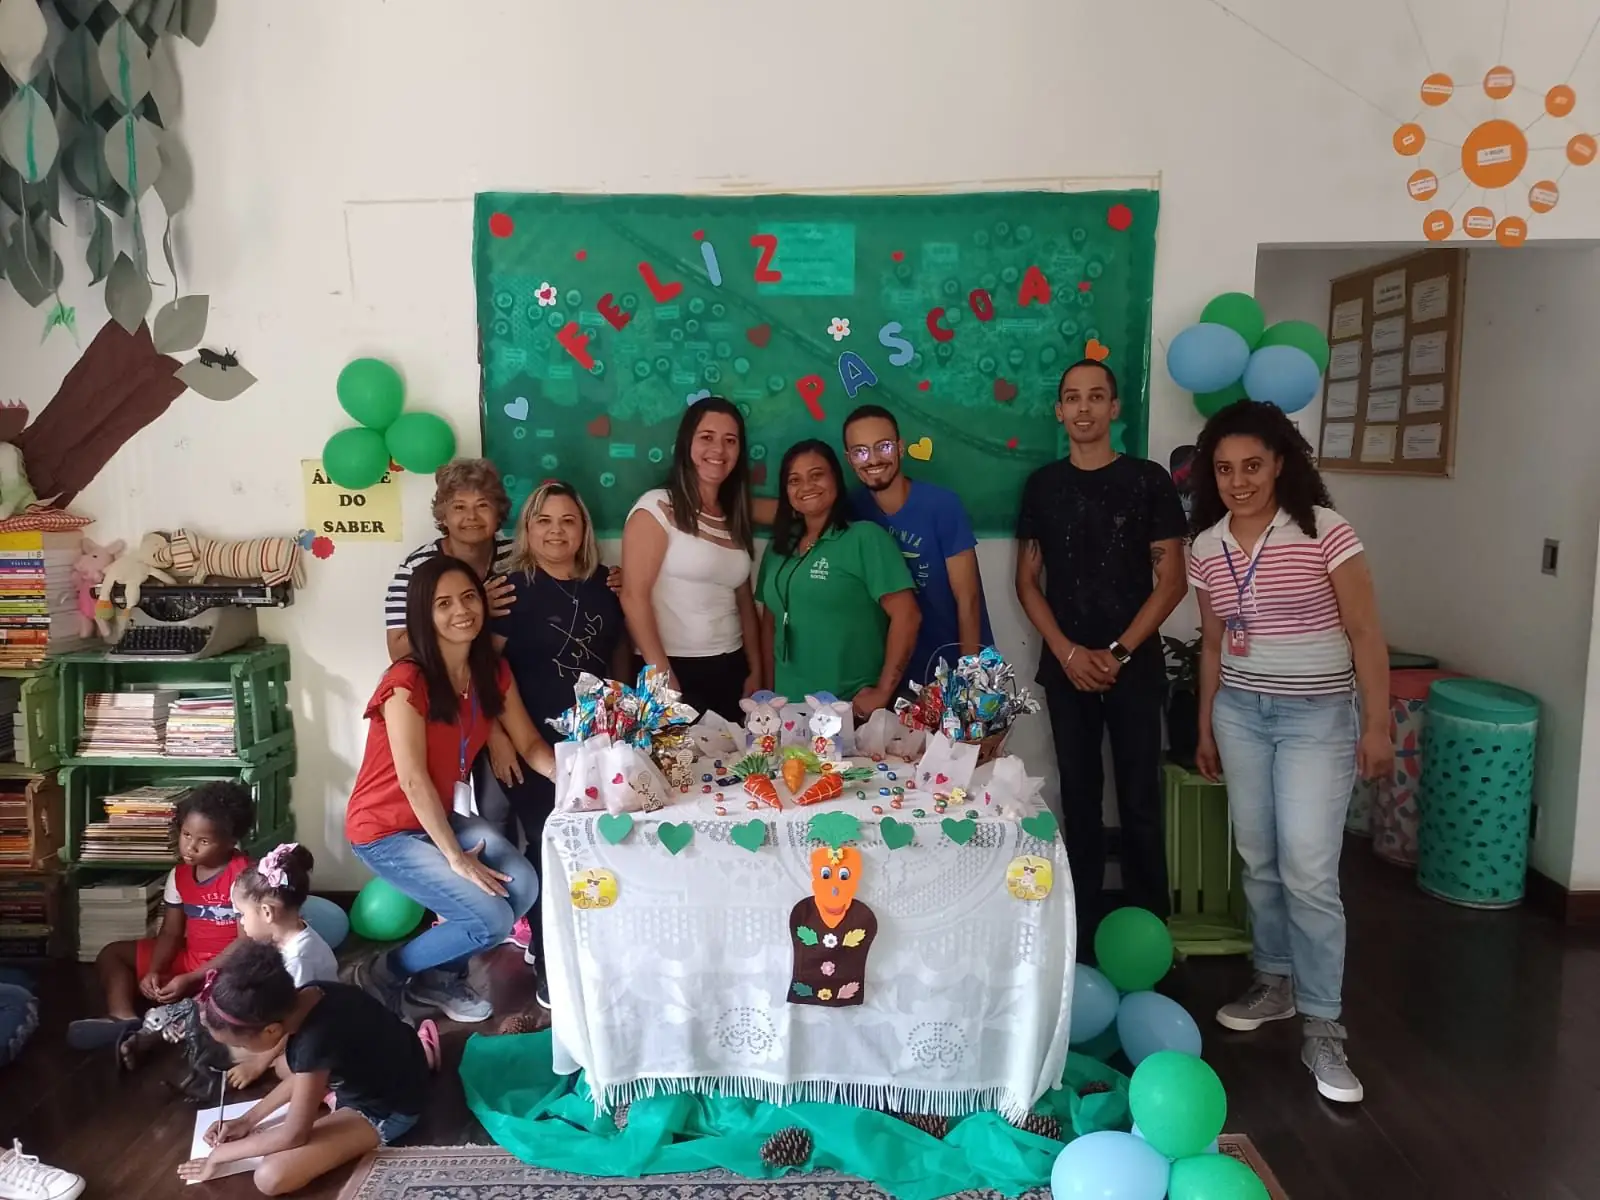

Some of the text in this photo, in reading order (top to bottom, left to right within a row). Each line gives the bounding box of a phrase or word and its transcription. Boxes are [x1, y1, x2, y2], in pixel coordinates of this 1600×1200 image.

[556, 233, 782, 370] FELIZ
[795, 265, 1052, 422] PASCOA
[339, 494, 366, 507] DO
[323, 520, 385, 533] SABER
